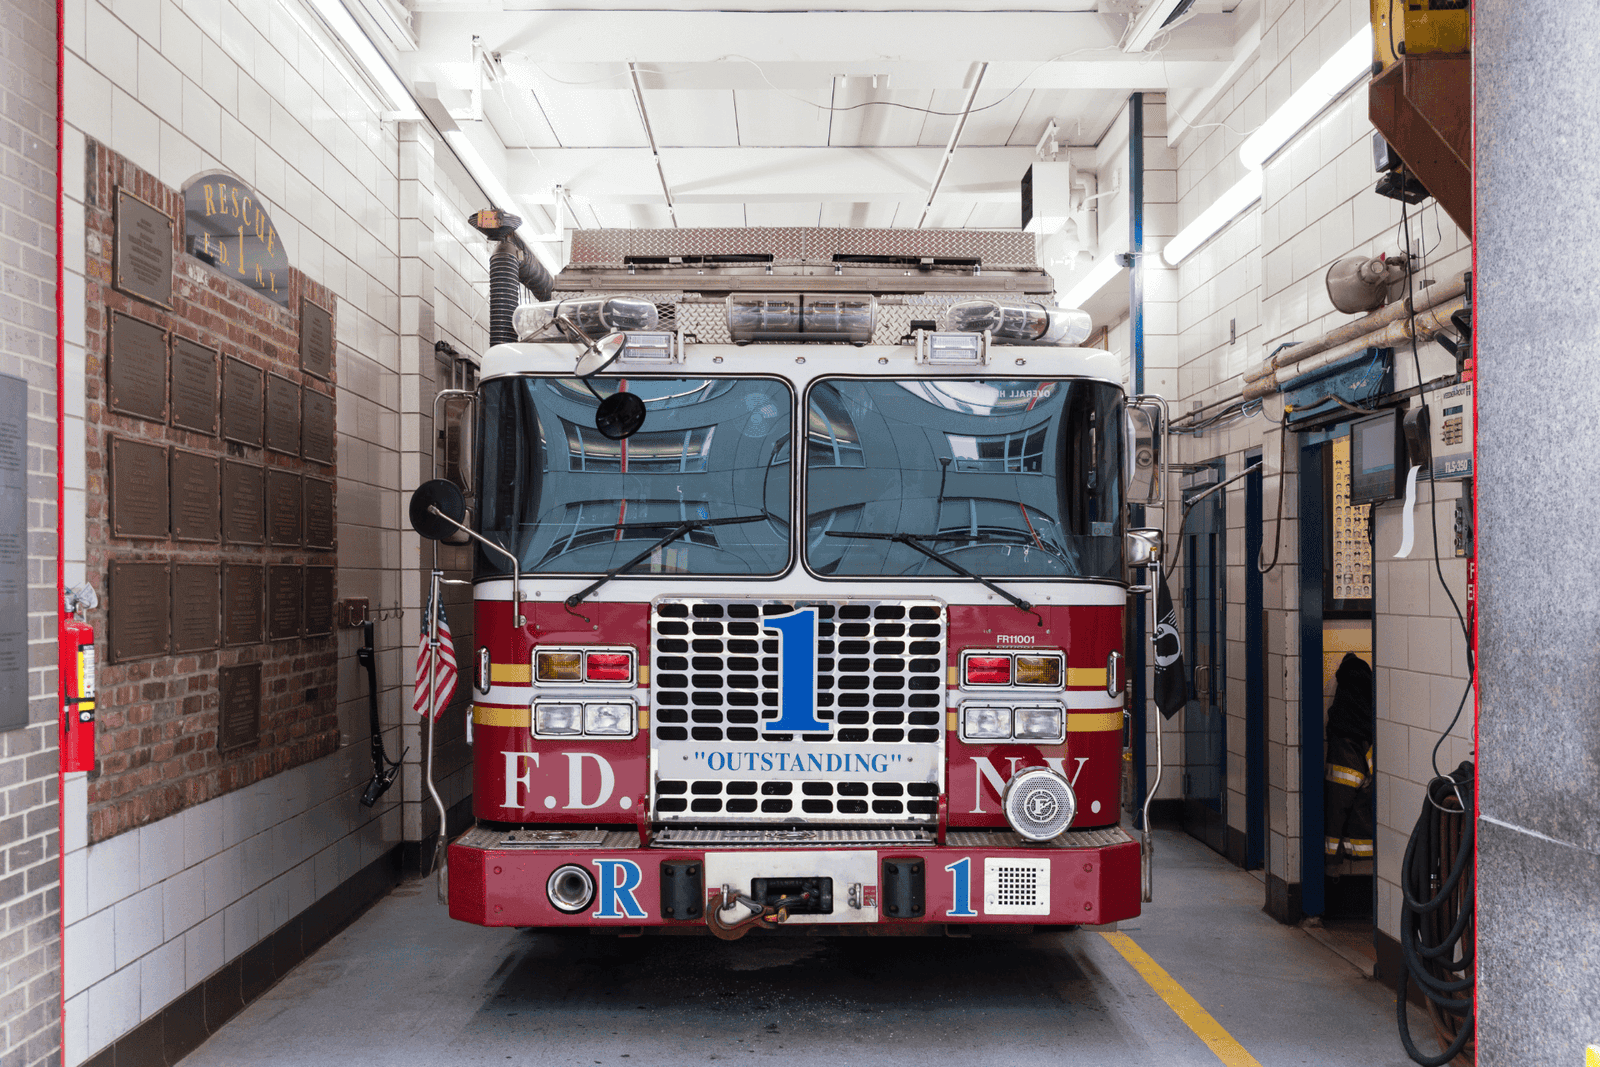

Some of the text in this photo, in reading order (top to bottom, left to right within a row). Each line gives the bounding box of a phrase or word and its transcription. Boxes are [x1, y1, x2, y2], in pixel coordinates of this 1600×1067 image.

[203, 183, 276, 258] RESCUE
[238, 225, 246, 275] 1
[996, 634, 1035, 644] FR11001
[762, 607, 832, 733] 1
[500, 751, 633, 810] F.D.
[694, 751, 902, 773] "OUTSTANDING"
[592, 857, 979, 920] R 1
